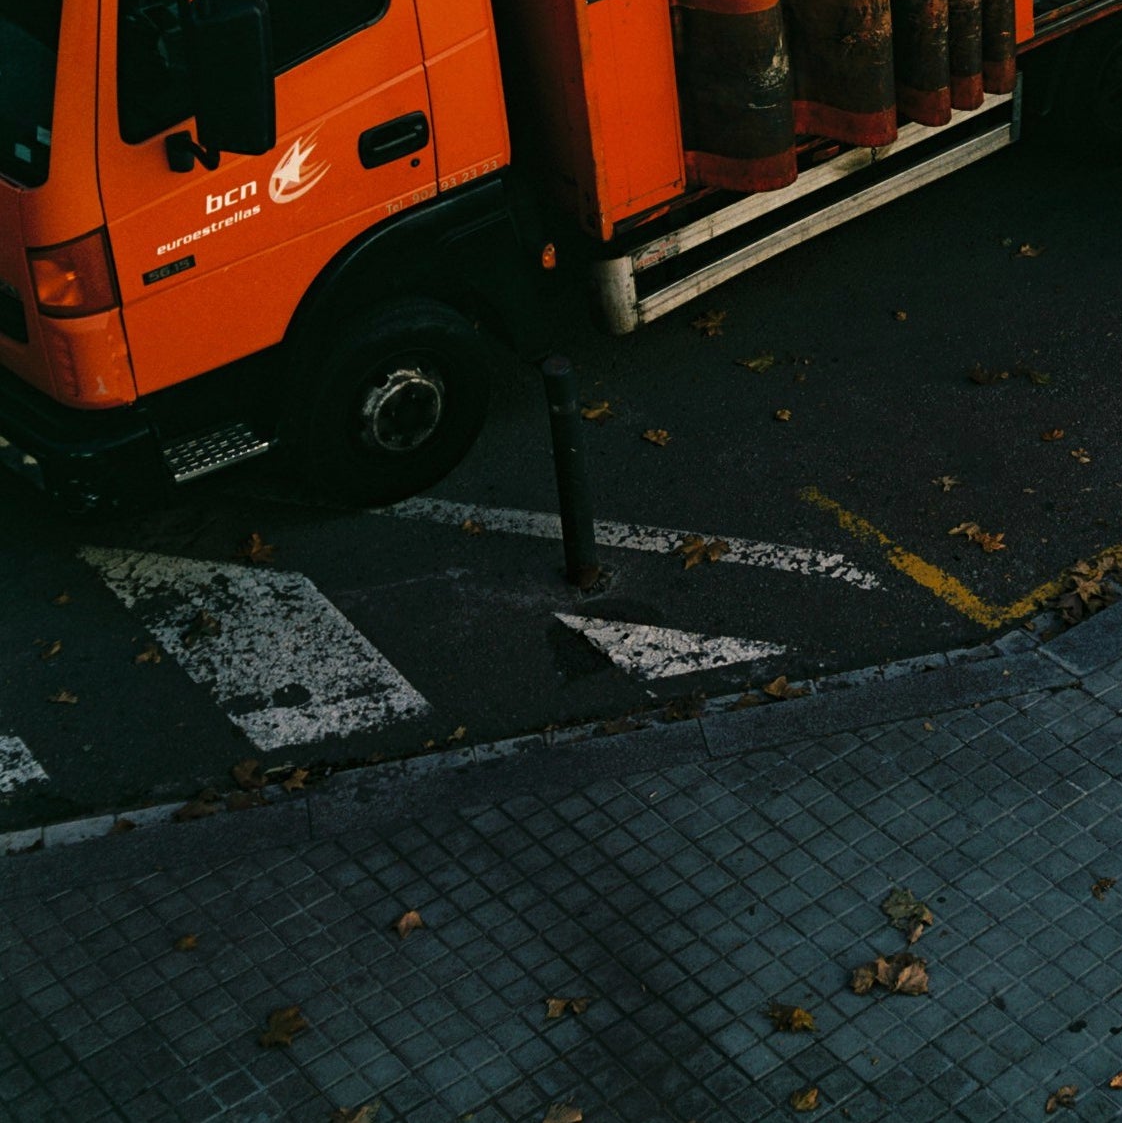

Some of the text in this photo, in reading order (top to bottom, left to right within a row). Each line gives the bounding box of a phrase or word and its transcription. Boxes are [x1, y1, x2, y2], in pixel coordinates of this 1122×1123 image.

[440, 177, 457, 192] 93
[462, 169, 477, 184] 23
[482, 160, 499, 175] 23
[205, 180, 258, 215] bcn
[156, 204, 261, 257] euroestrellas
